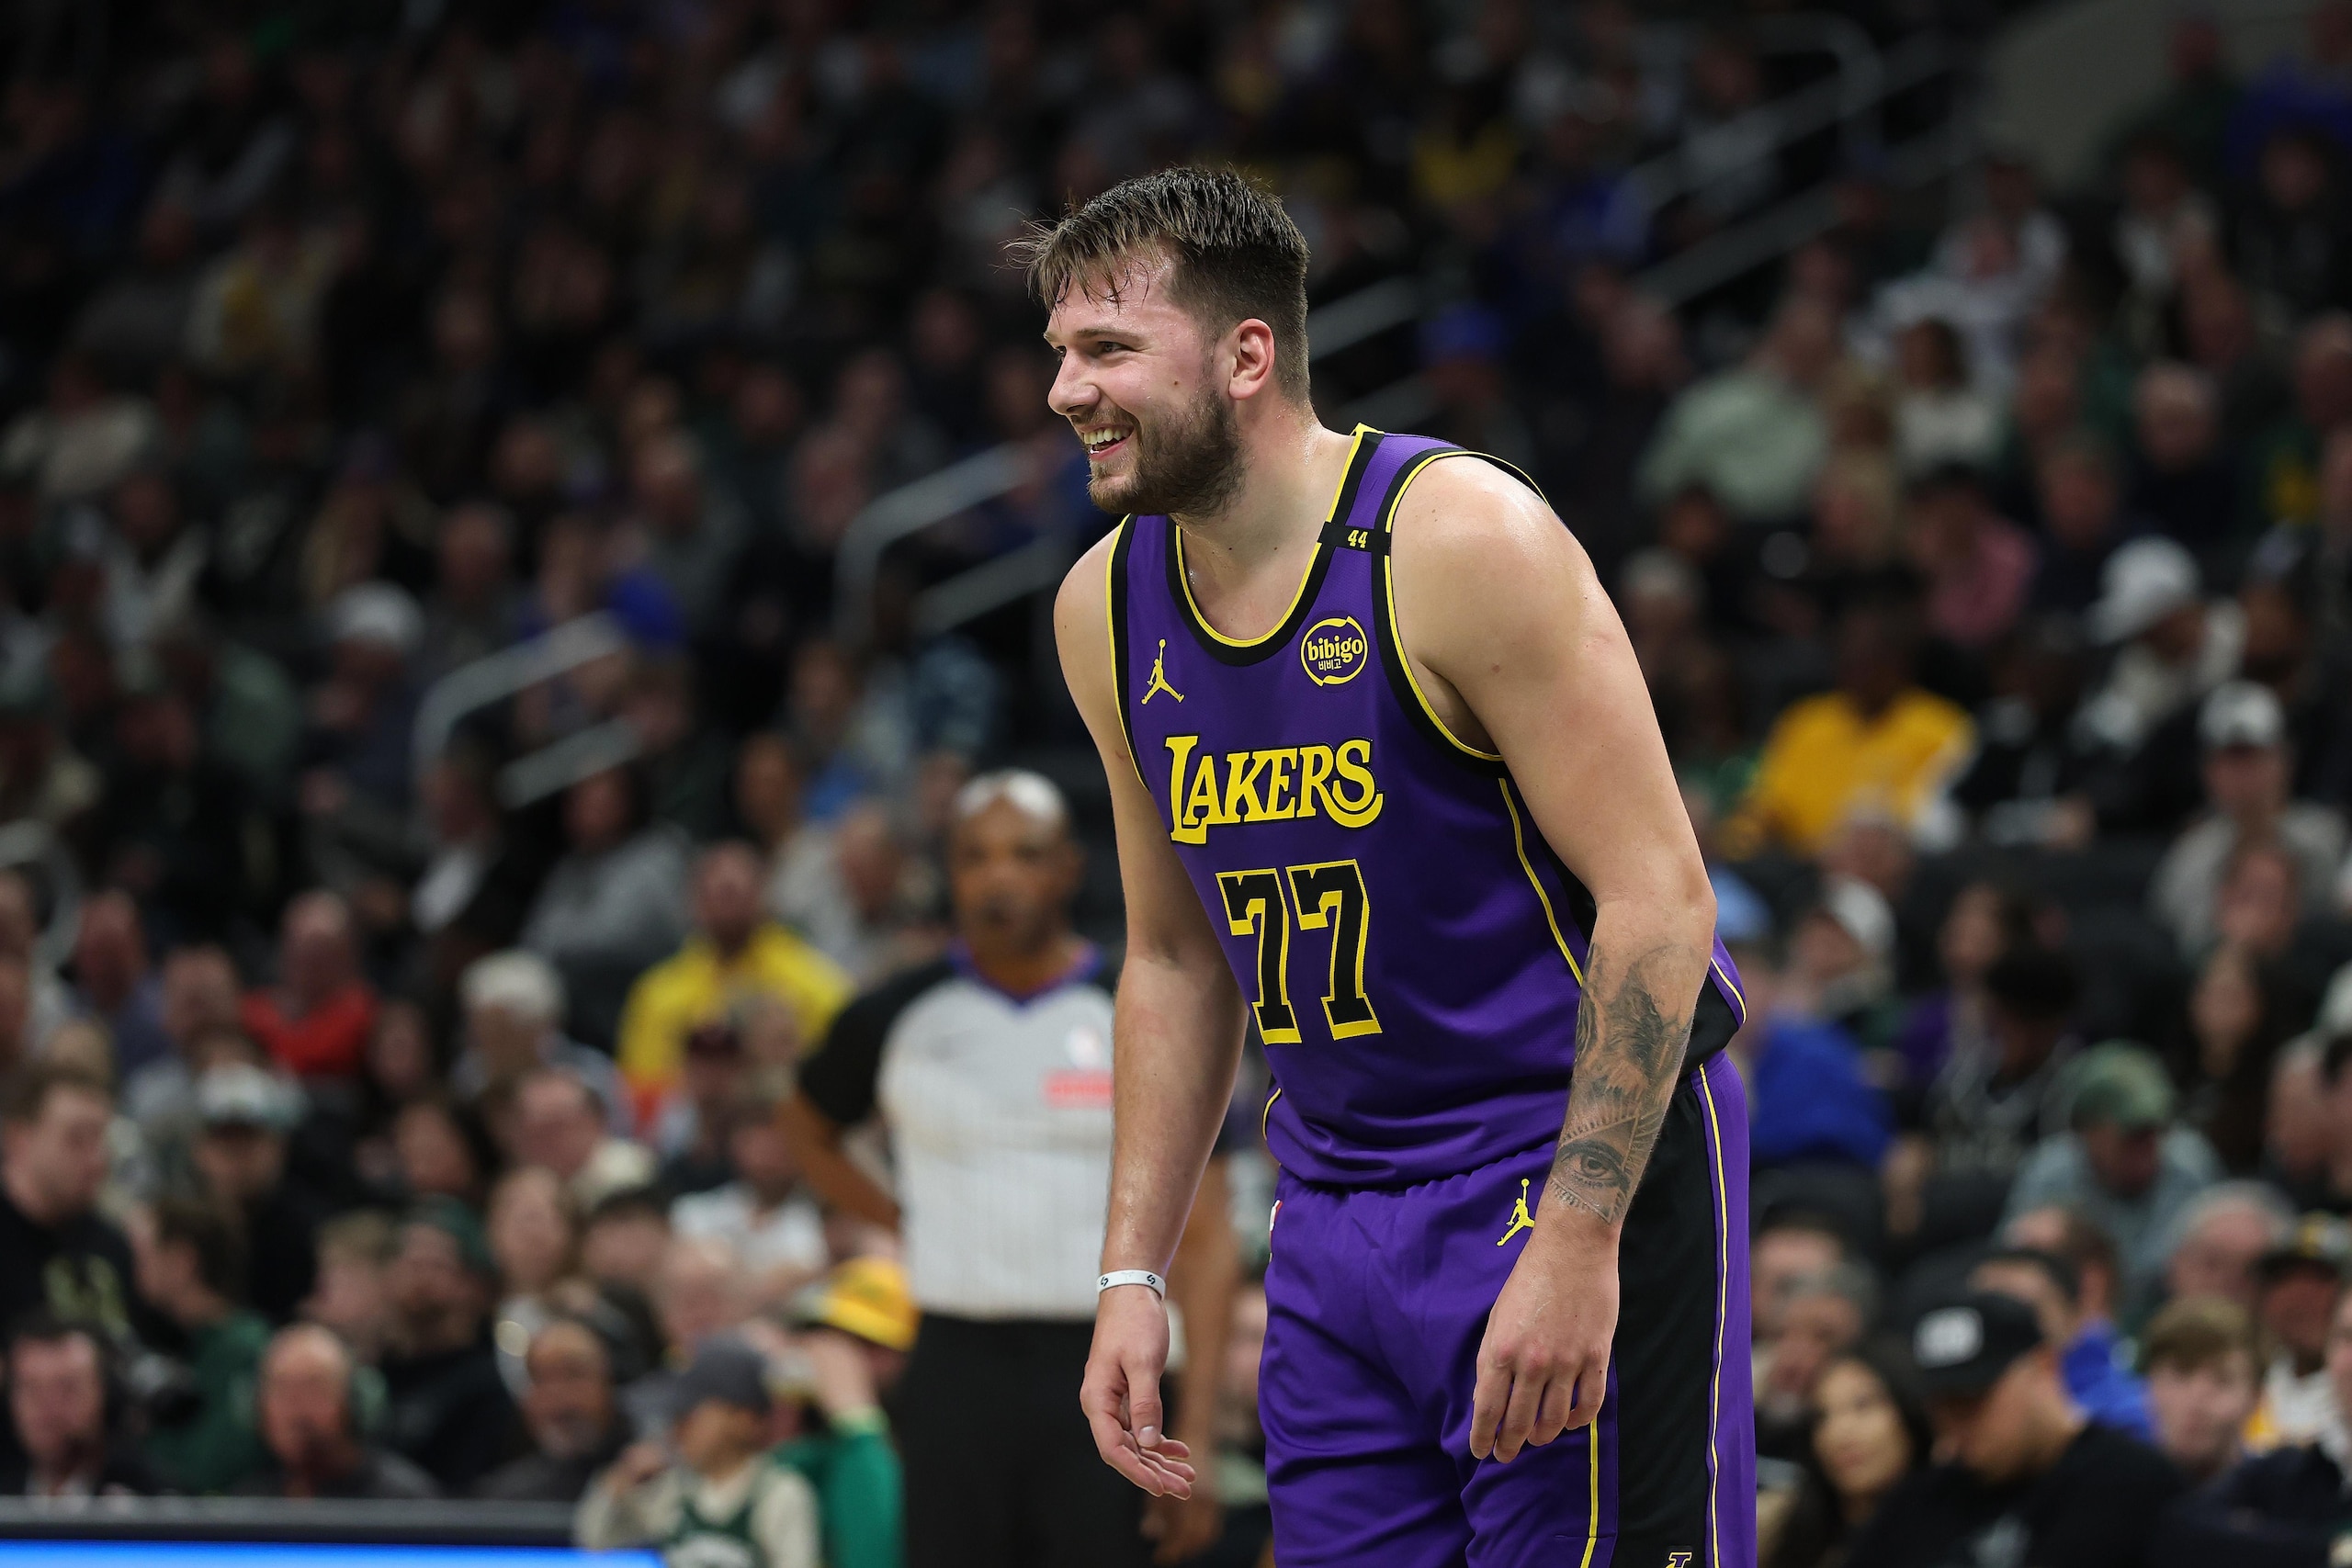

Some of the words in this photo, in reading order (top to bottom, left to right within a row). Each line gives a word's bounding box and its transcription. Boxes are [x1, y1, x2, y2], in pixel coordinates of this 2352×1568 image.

[1348, 529, 1369, 548] 44
[1307, 635, 1363, 663] bibigo
[1317, 659, 1342, 671] 비비고
[1164, 735, 1384, 844] LAKERS
[1215, 858, 1383, 1045] 77
